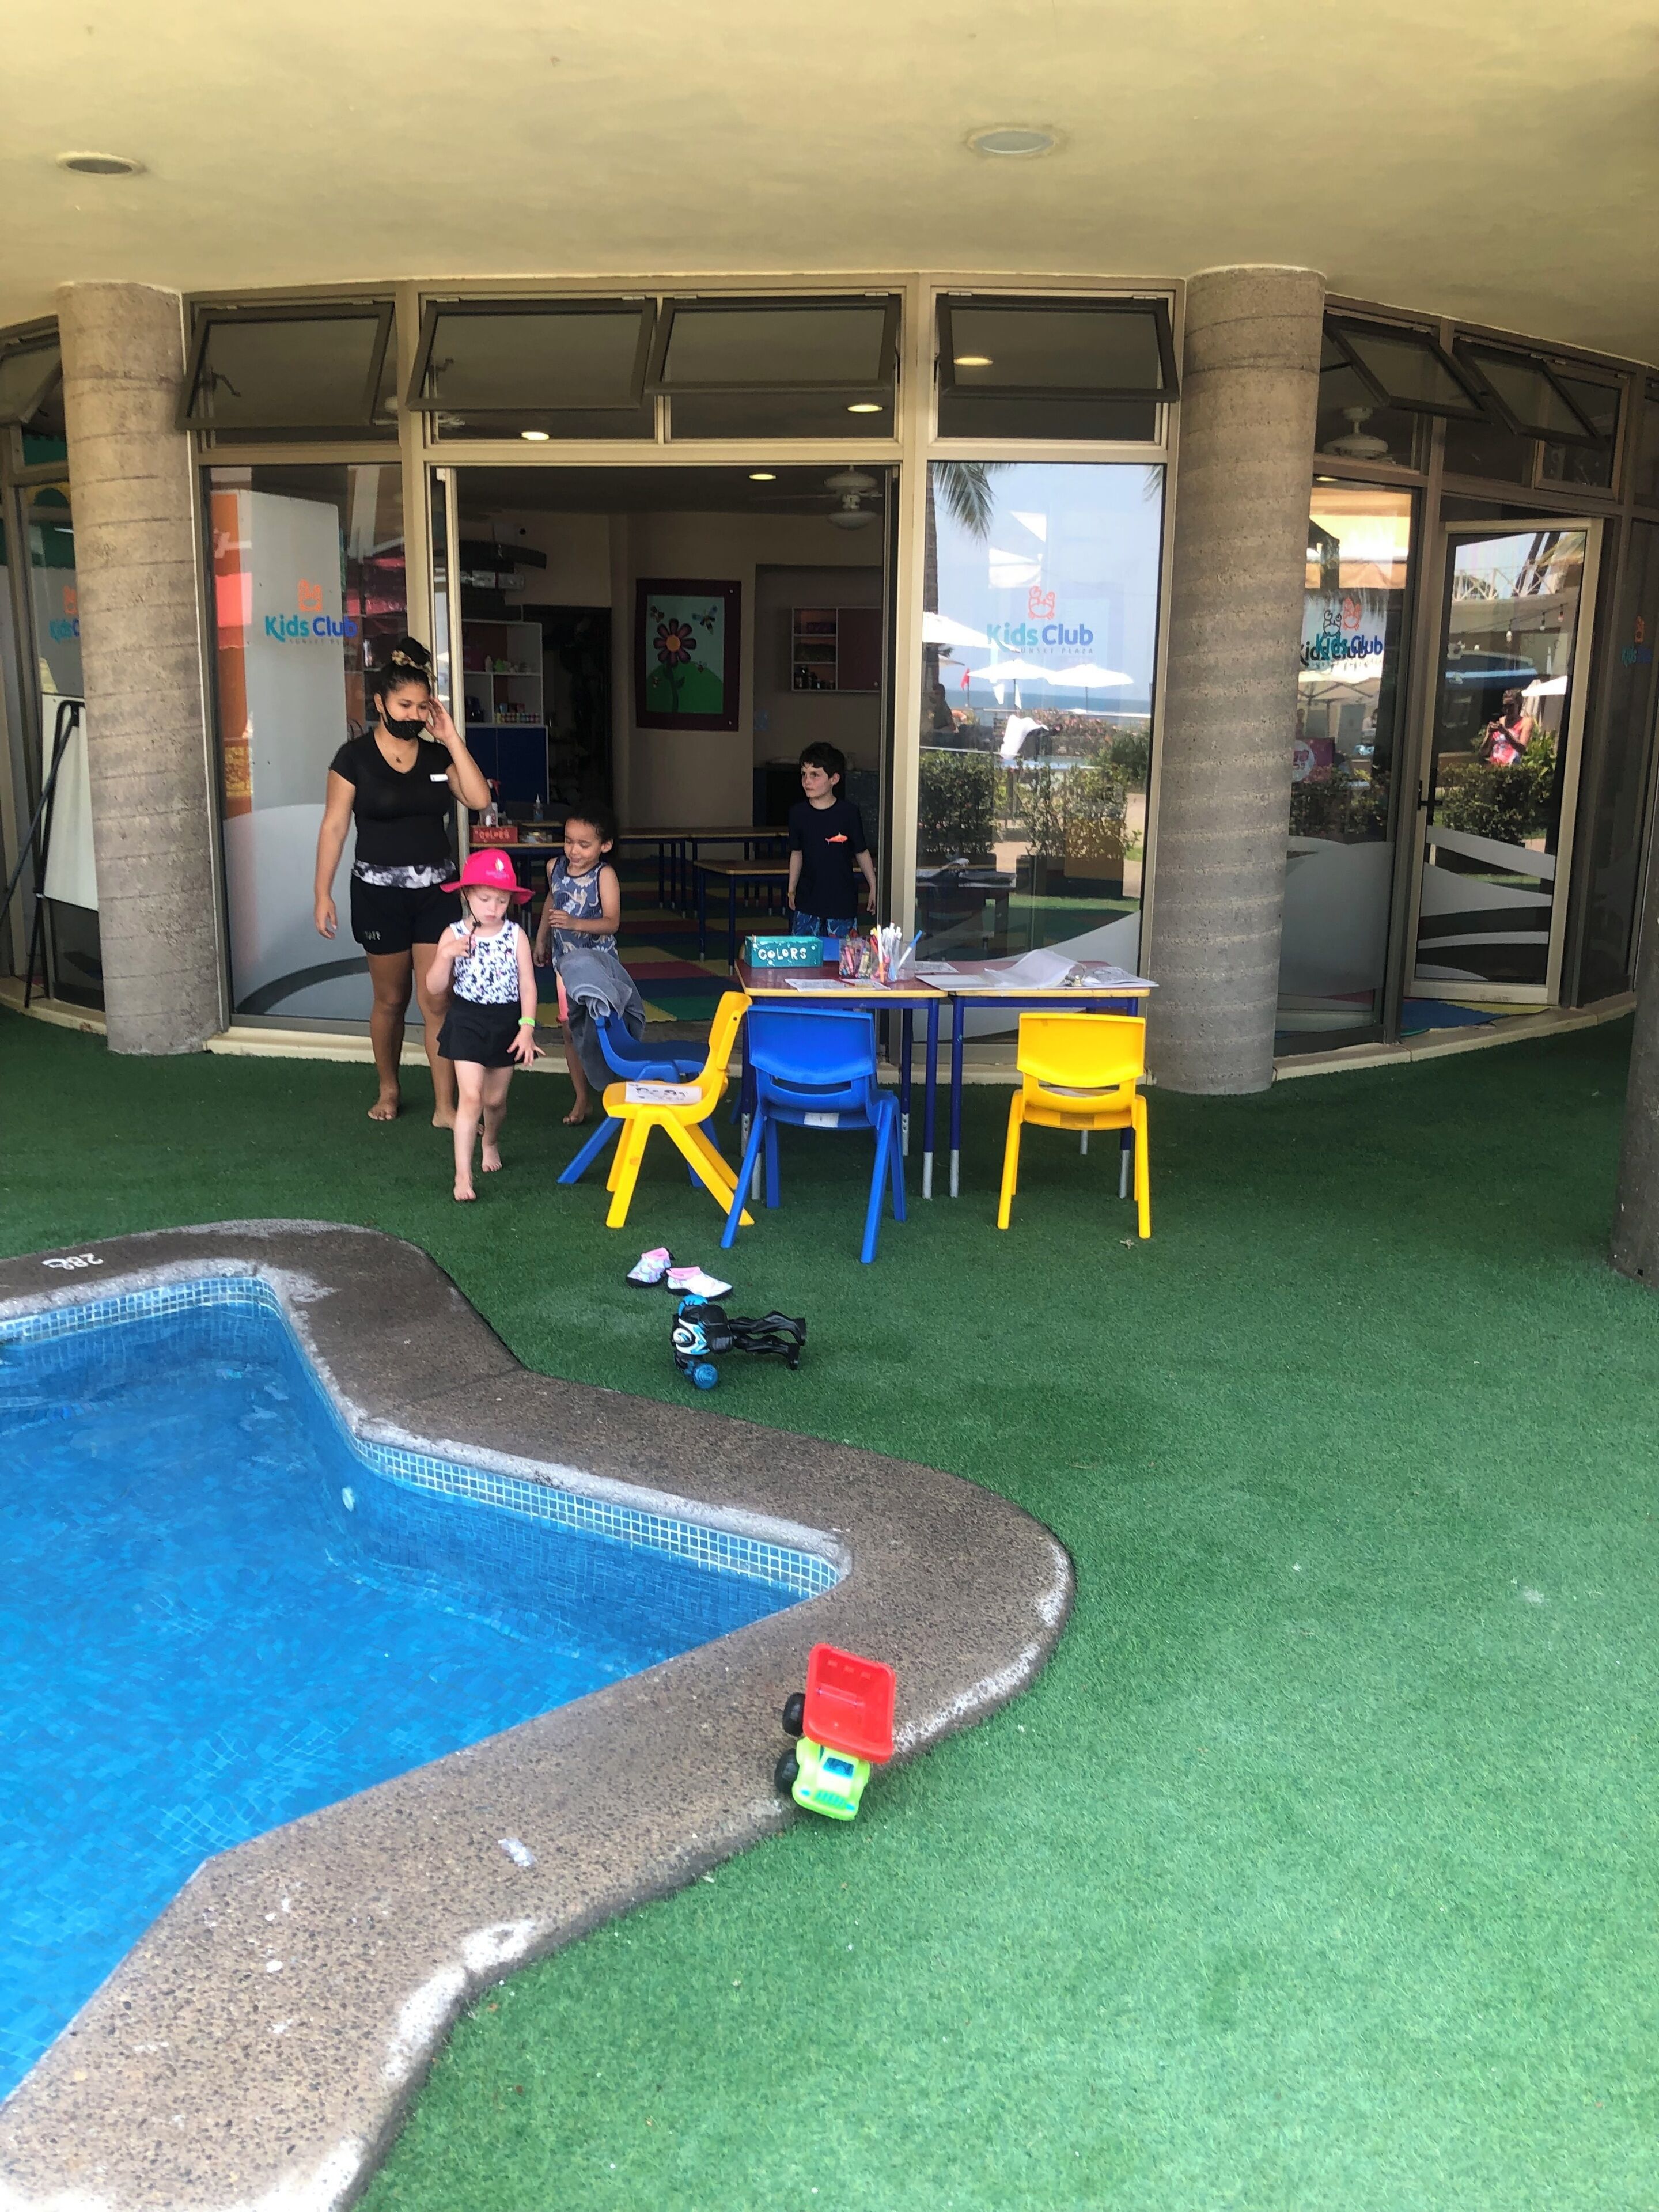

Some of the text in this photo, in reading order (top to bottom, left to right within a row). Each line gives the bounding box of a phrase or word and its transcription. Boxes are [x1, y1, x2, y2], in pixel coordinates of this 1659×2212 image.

[264, 613, 358, 642] Kids Club
[987, 622, 1093, 653] Kids Club
[1316, 632, 1382, 662] Kids Club
[757, 947, 806, 960] COLORS
